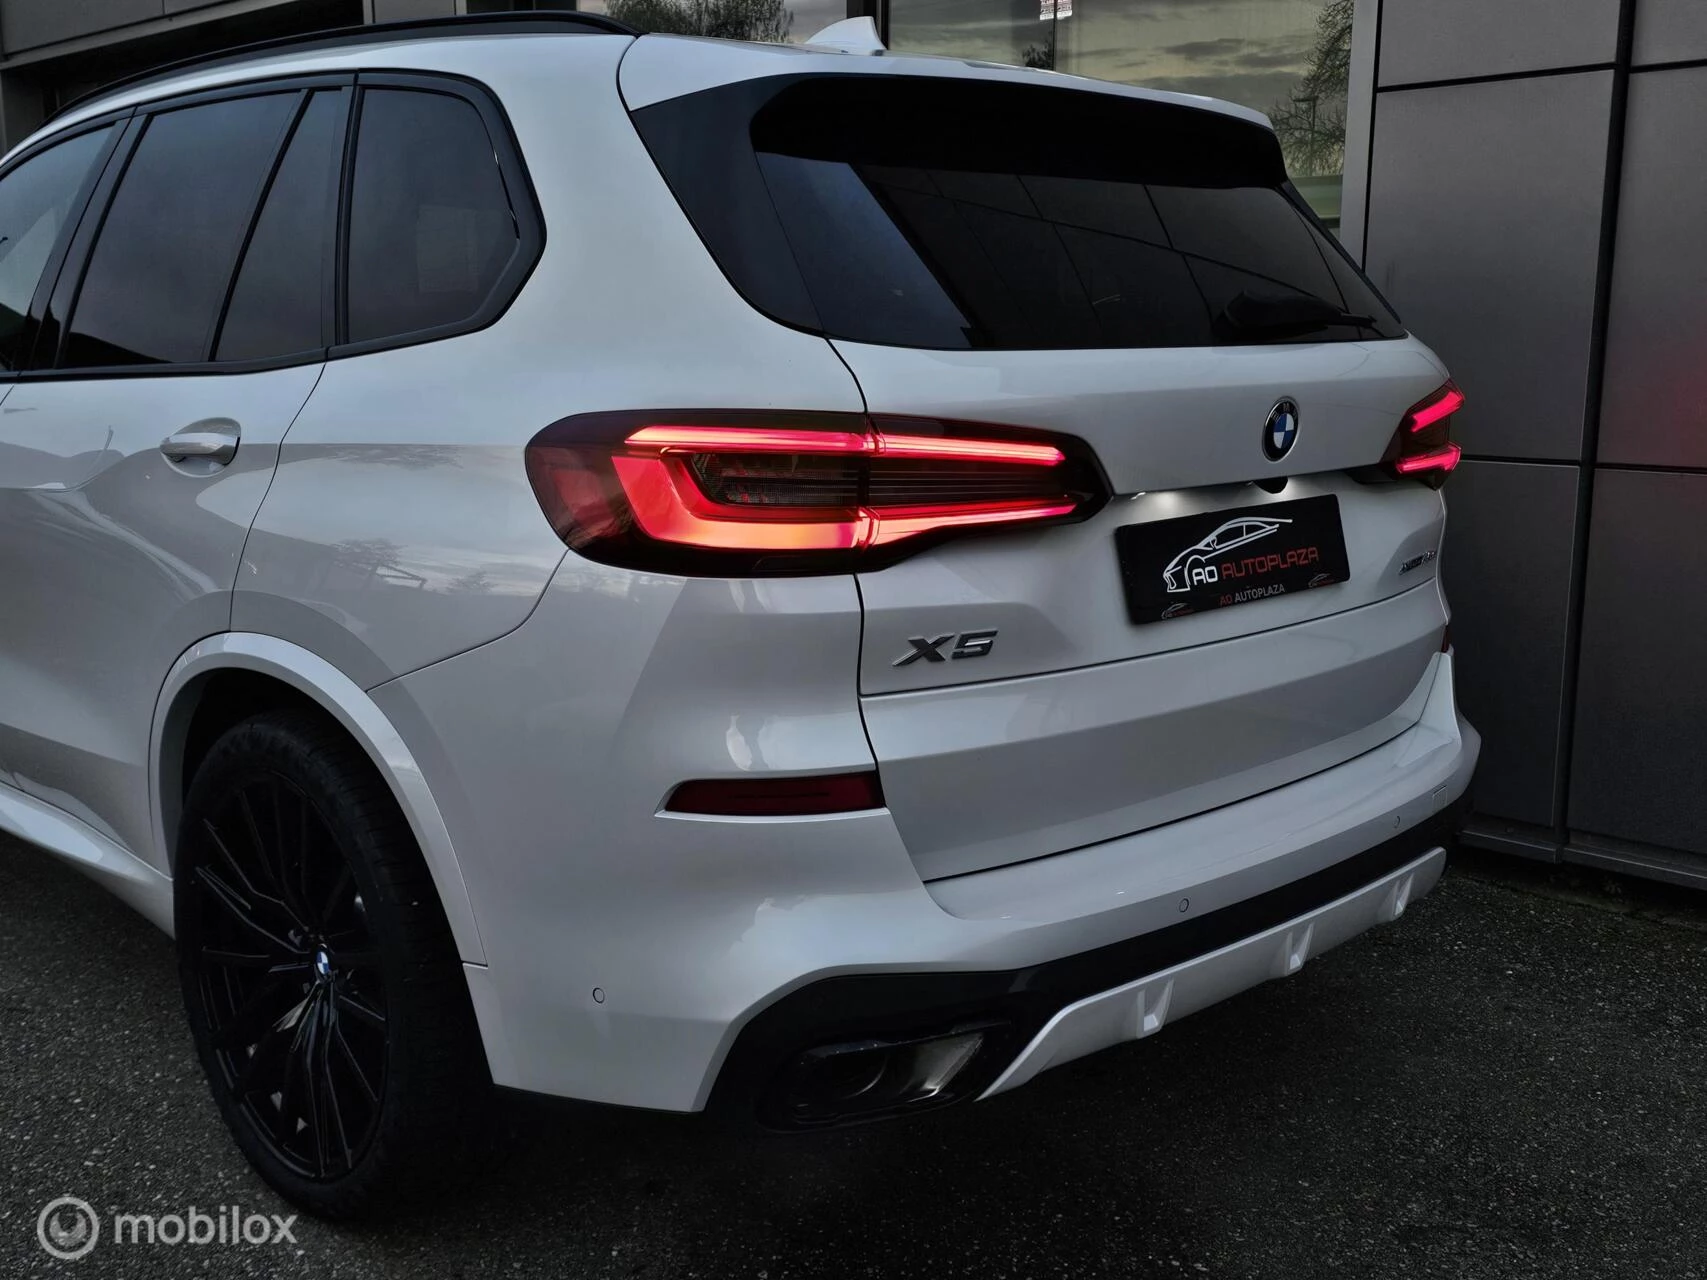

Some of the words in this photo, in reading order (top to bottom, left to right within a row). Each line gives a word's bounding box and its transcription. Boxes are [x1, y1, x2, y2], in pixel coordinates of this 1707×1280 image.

[1221, 546, 1319, 580] AUTOPLAZA
[1234, 583, 1286, 603] AUTOPLAZA
[892, 628, 999, 667] X5
